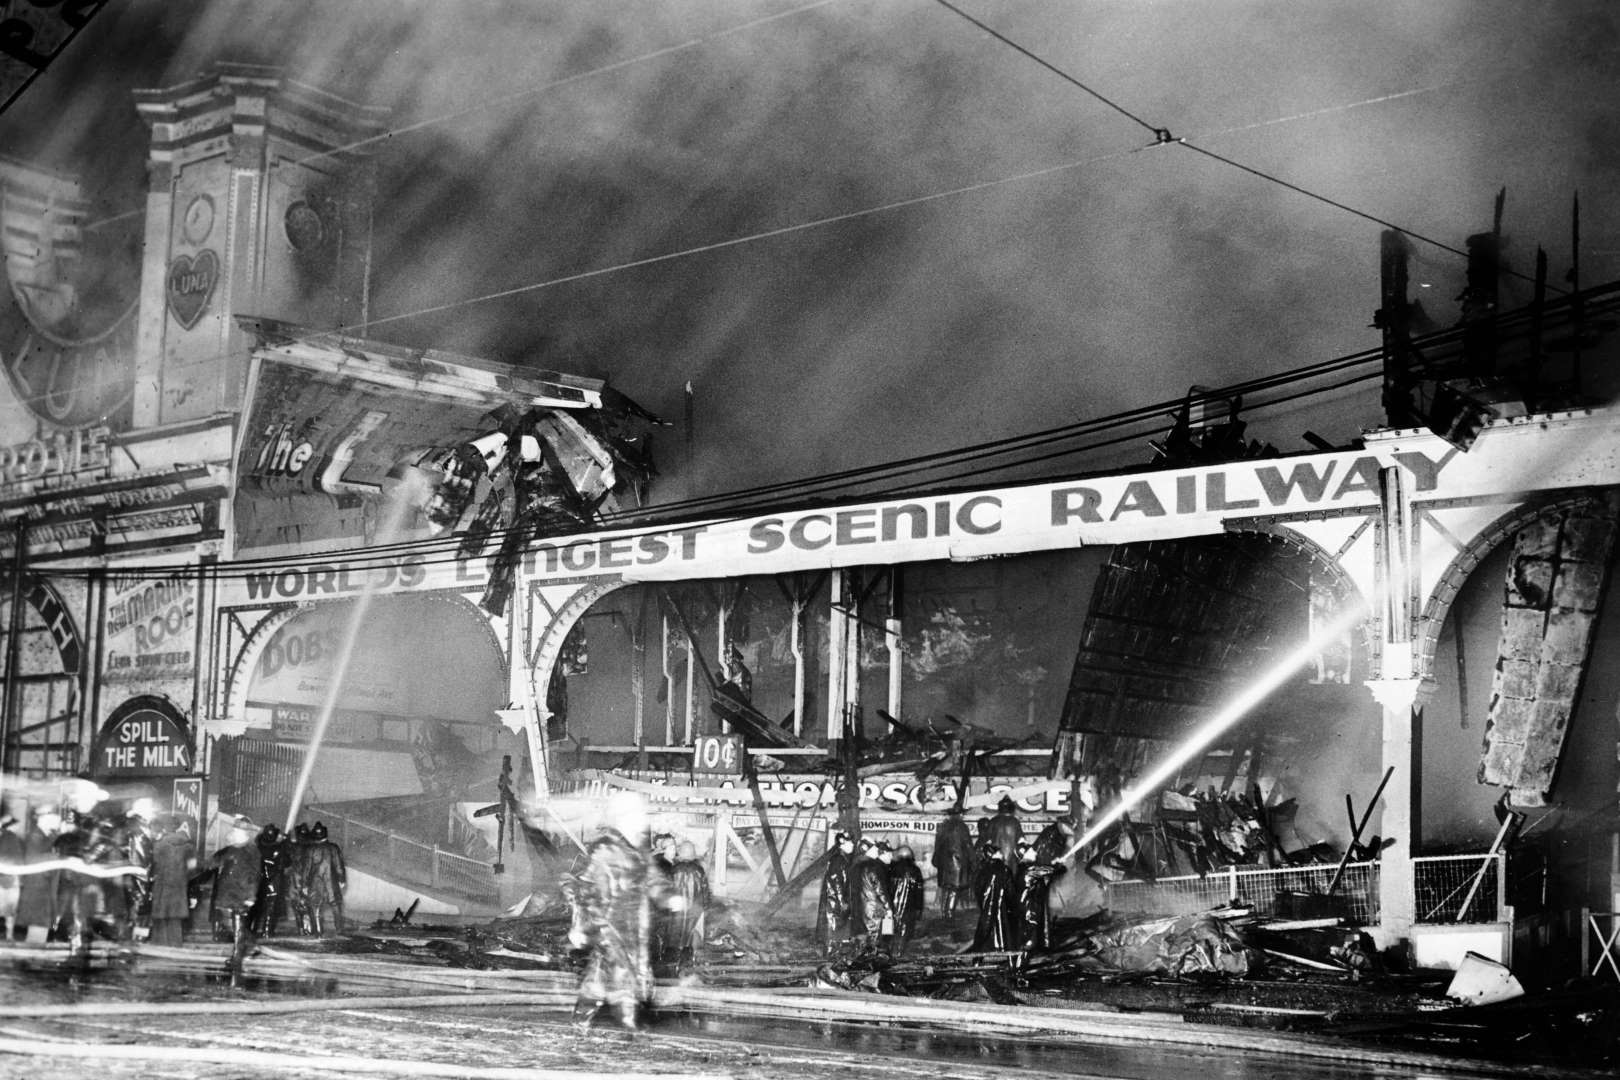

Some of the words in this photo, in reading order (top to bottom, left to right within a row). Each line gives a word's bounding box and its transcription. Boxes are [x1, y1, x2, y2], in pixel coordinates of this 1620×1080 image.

[171, 271, 208, 295] LUNA
[256, 423, 313, 476] The
[104, 485, 172, 508] WORLD
[455, 526, 705, 583] LNGEST
[747, 495, 1003, 556] SCENIC
[1050, 445, 1456, 527] RAILWAY
[136, 597, 194, 654] ROOF
[120, 721, 170, 744] SPILL
[105, 747, 136, 768] THE
[143, 744, 188, 768] MILK
[692, 737, 735, 769] 10¢
[176, 789, 200, 821] WIN
[859, 820, 909, 829] HOMPSON
